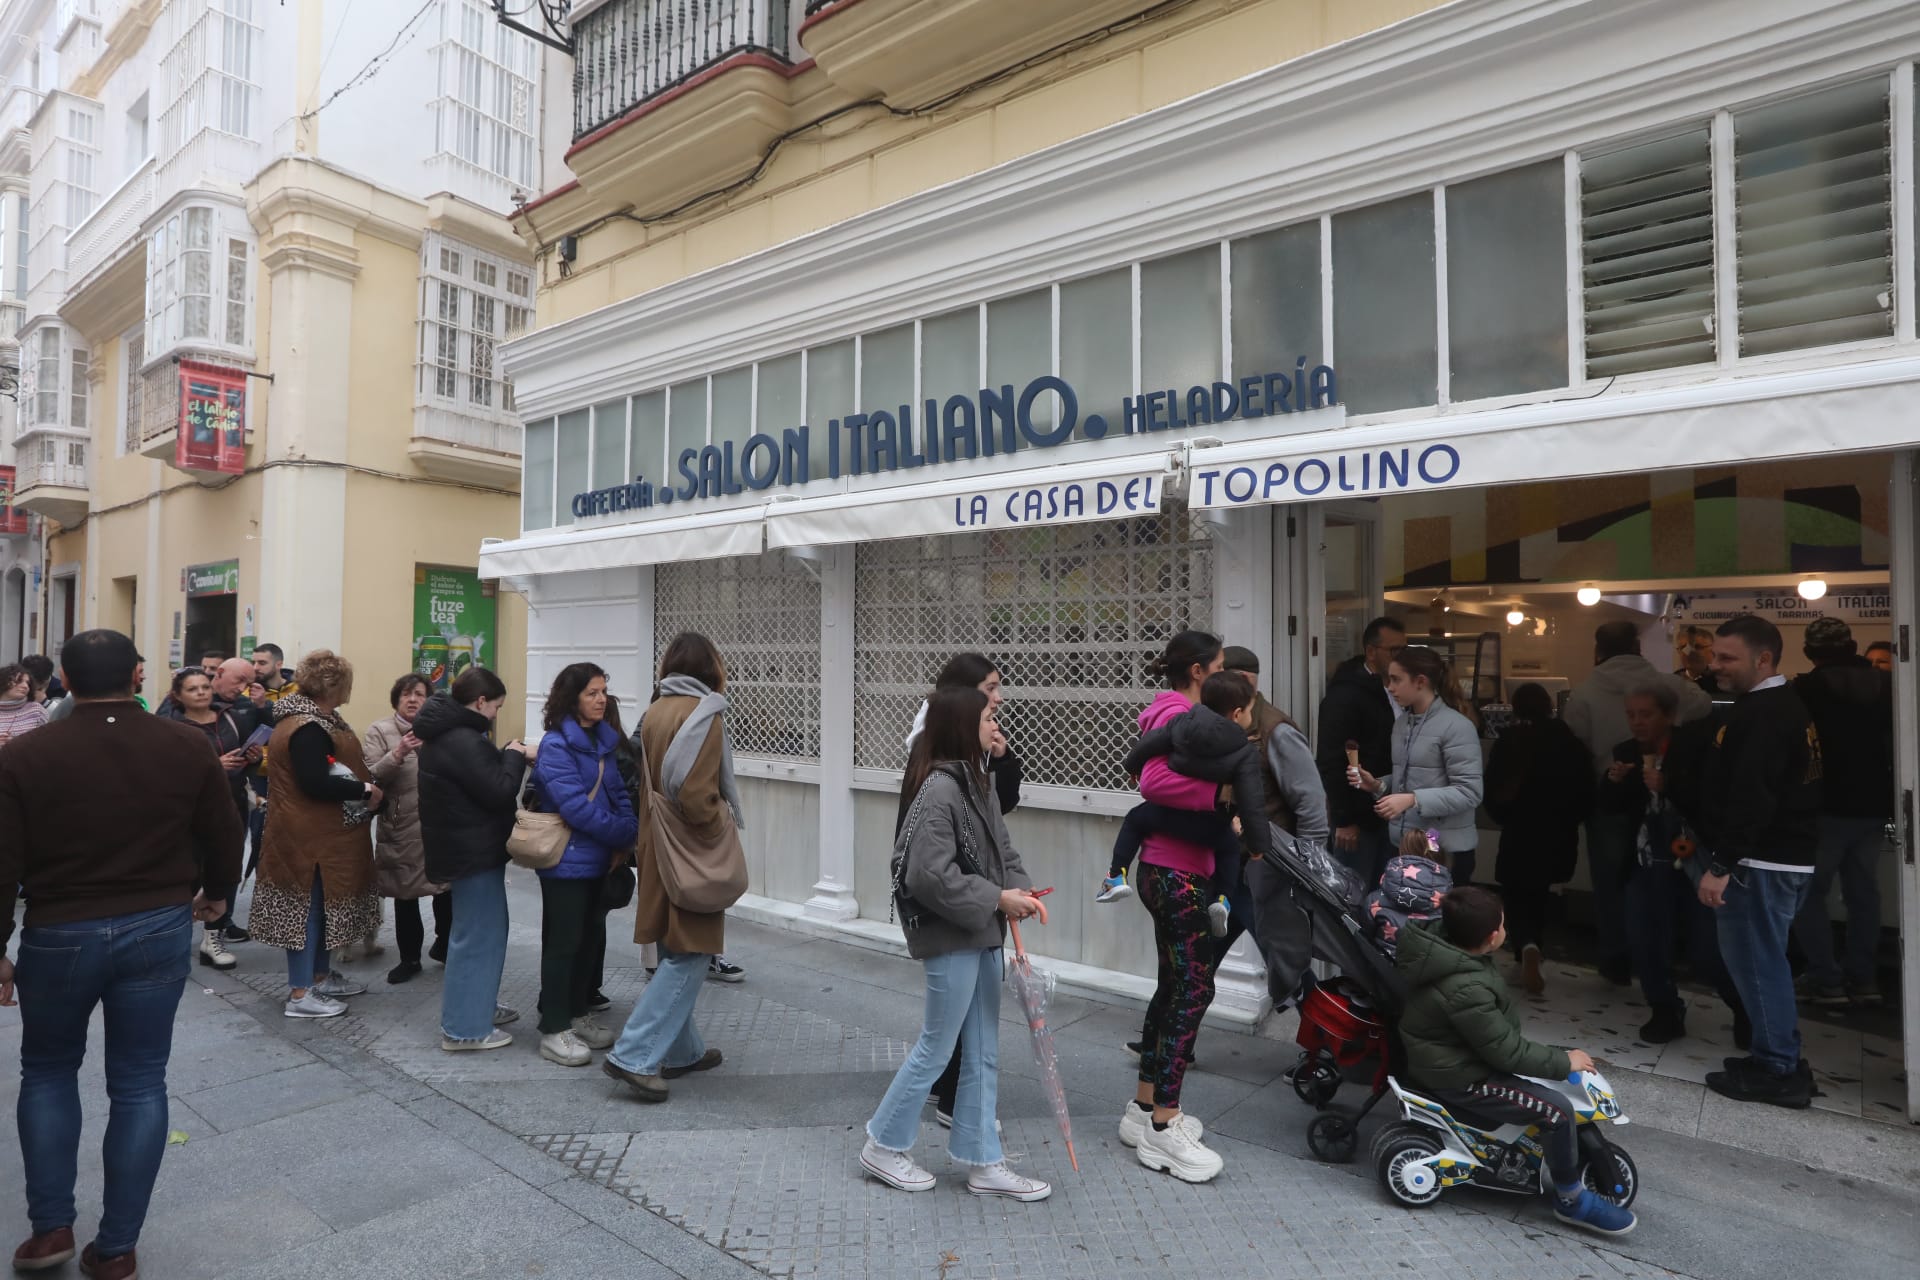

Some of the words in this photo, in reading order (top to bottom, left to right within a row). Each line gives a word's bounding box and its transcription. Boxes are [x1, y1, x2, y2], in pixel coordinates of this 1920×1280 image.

[571, 475, 654, 517] CAFETERÍA
[677, 425, 809, 501] SALON
[828, 375, 1079, 479] ITALIANO
[1122, 355, 1338, 435] HELADERÍA
[955, 495, 988, 527] LA
[1005, 484, 1084, 523] CASA
[1096, 477, 1156, 515] DEL
[1198, 444, 1461, 506] TOPOLINO
[430, 595, 465, 613] fuze
[430, 610, 456, 624] tea
